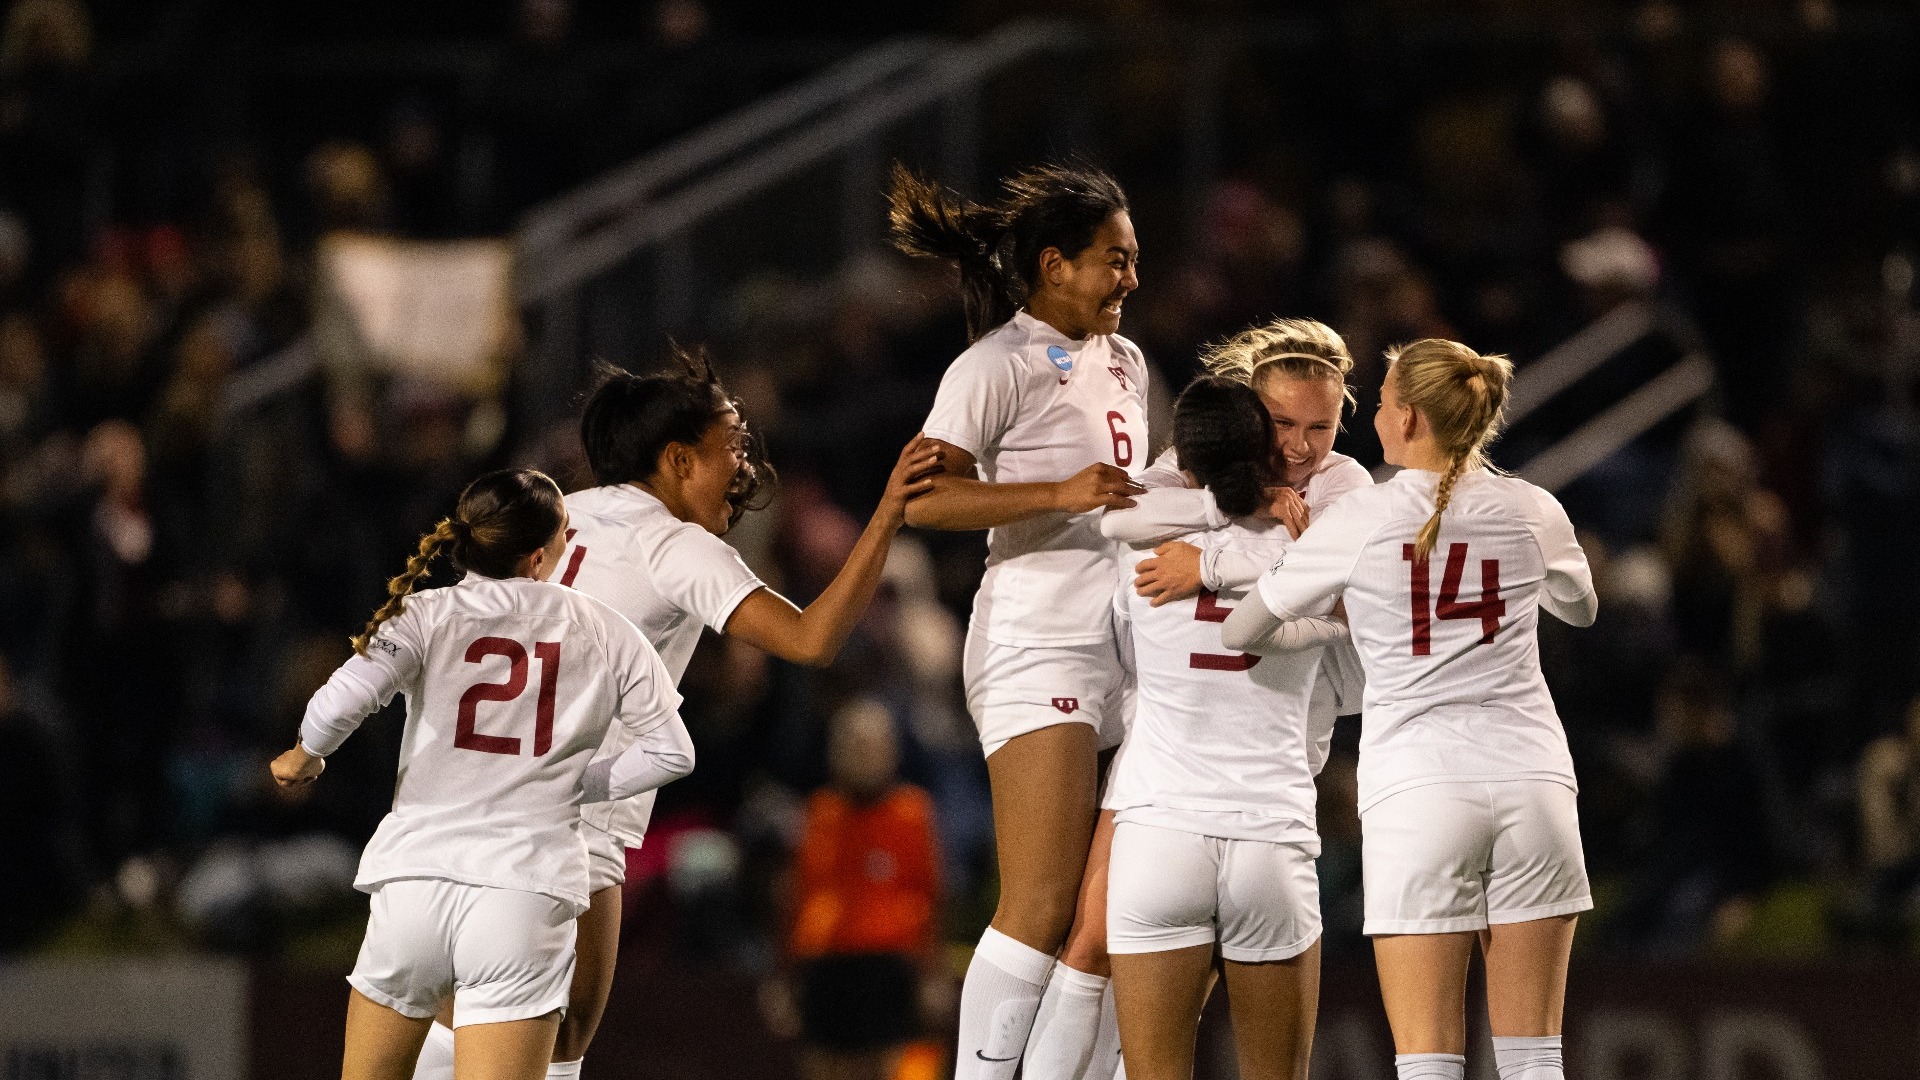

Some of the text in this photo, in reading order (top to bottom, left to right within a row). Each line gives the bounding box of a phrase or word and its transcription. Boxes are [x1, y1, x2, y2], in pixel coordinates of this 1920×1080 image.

[1106, 410, 1133, 467] 6
[1403, 543, 1506, 656] 14
[454, 636, 561, 757] 21
